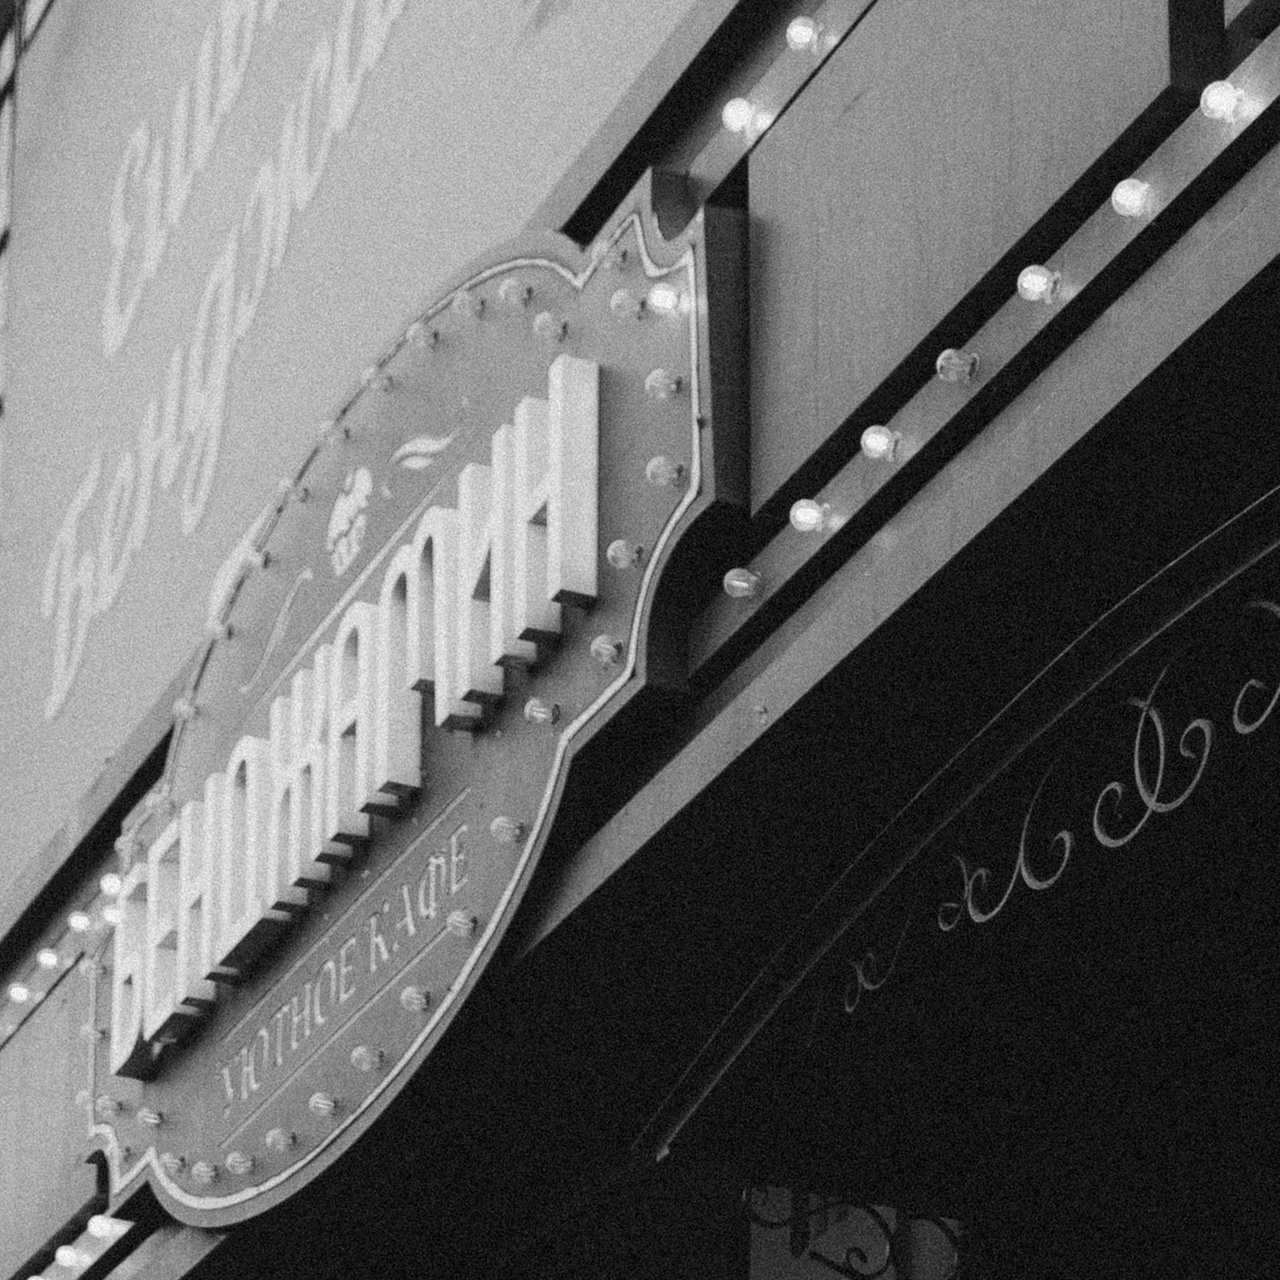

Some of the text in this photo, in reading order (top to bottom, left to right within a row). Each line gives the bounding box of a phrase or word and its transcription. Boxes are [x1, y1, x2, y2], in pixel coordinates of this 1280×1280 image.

[112, 350, 600, 1078] БЕНДЖАМИН
[222, 822, 471, 1116] УЮТНОЕ КАФЕ
